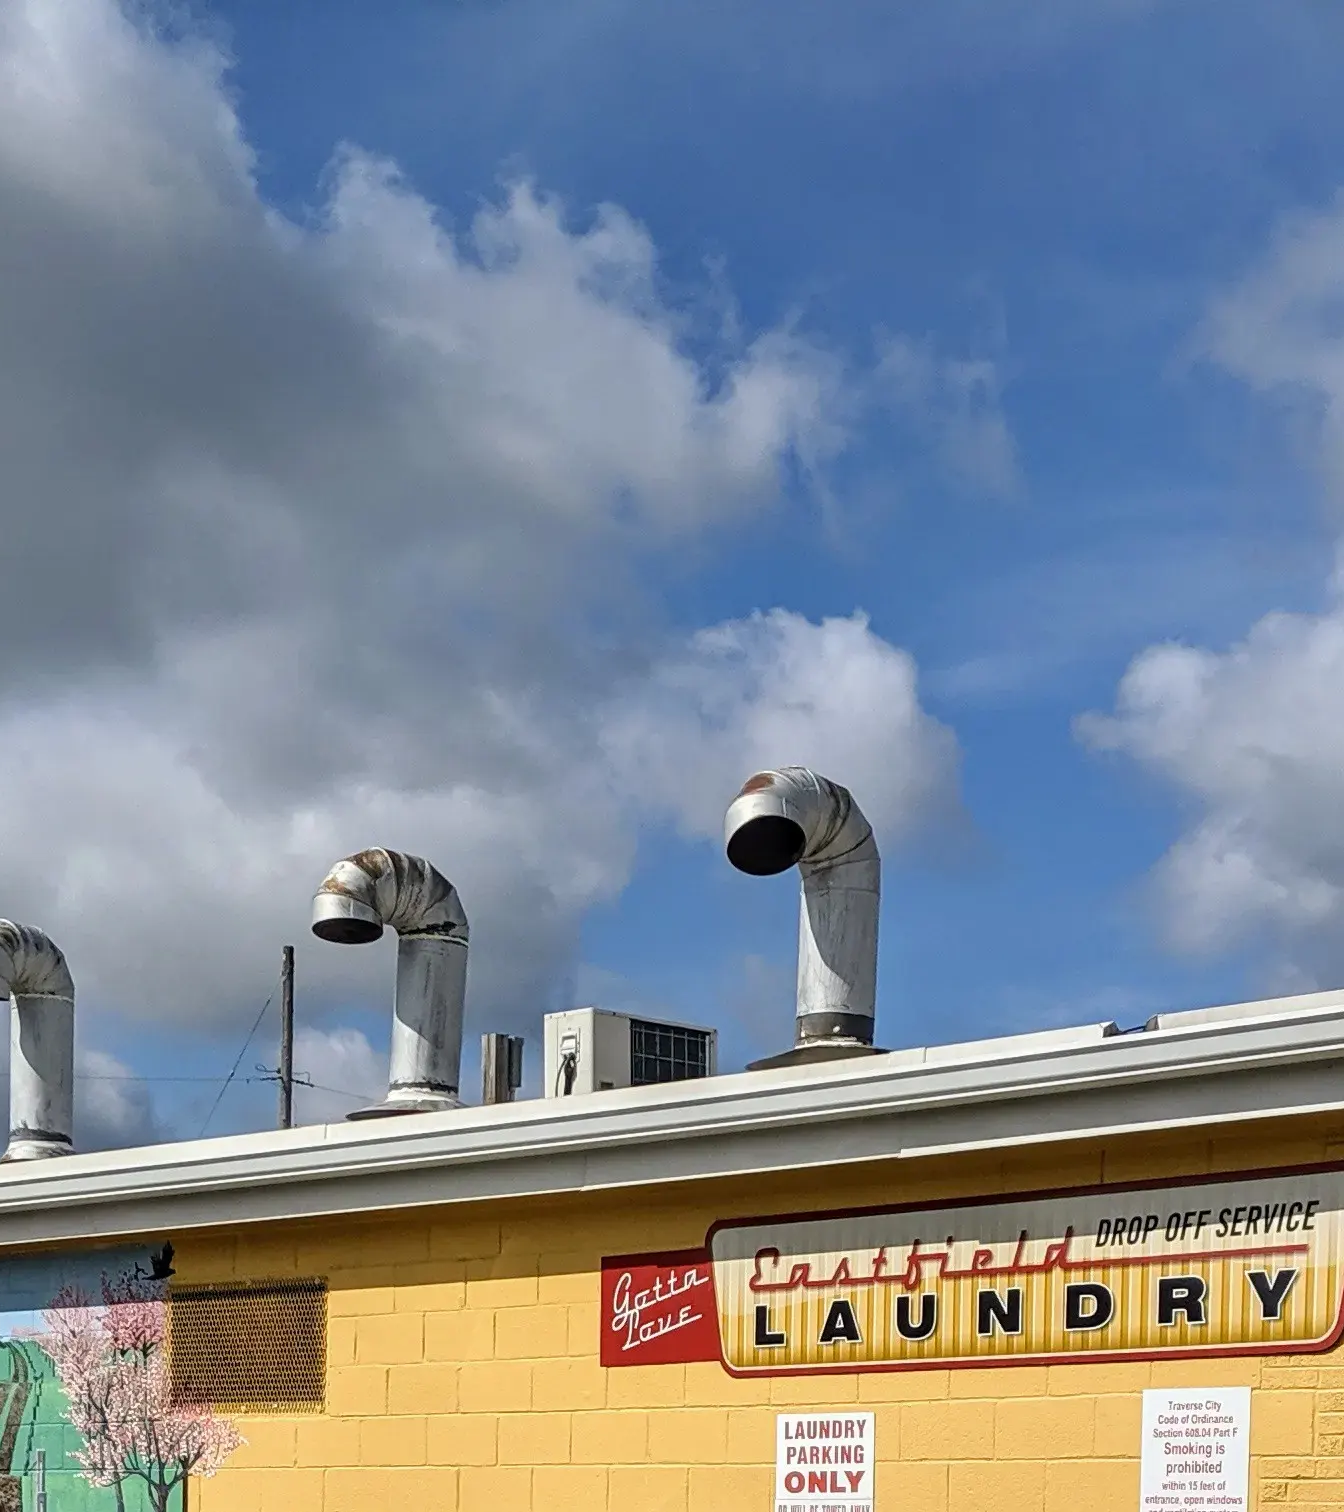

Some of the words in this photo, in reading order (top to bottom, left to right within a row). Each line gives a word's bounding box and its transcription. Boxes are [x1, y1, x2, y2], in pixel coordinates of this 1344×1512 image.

[1094, 1214, 1159, 1248] DROP
[1165, 1208, 1212, 1243] OFF
[1215, 1199, 1320, 1239] SERVICE
[748, 1225, 1074, 1293] Eastfield
[612, 1268, 709, 1331] Gotta
[754, 1269, 1300, 1348] LAUNDRY
[1168, 1400, 1203, 1411] Traverse
[1205, 1400, 1222, 1412] City
[1158, 1414, 1179, 1425] Code
[1181, 1414, 1190, 1425] of
[1191, 1413, 1234, 1424] Ordinance
[784, 1419, 867, 1440] LAUNDRY
[1153, 1428, 1183, 1438] Section
[1213, 1427, 1231, 1438] Part
[1232, 1427, 1239, 1437] F
[786, 1444, 865, 1465] PARKING
[1164, 1442, 1213, 1458] Smoking
[1215, 1442, 1226, 1455] is
[1166, 1460, 1223, 1476] prohibited
[784, 1470, 866, 1494] ONLY
[1161, 1481, 1186, 1491] within
[1188, 1481, 1198, 1491] 15
[1199, 1480, 1216, 1491] feet
[1217, 1480, 1227, 1490] of
[1184, 1496, 1205, 1506] open
[1206, 1495, 1243, 1505] windows
